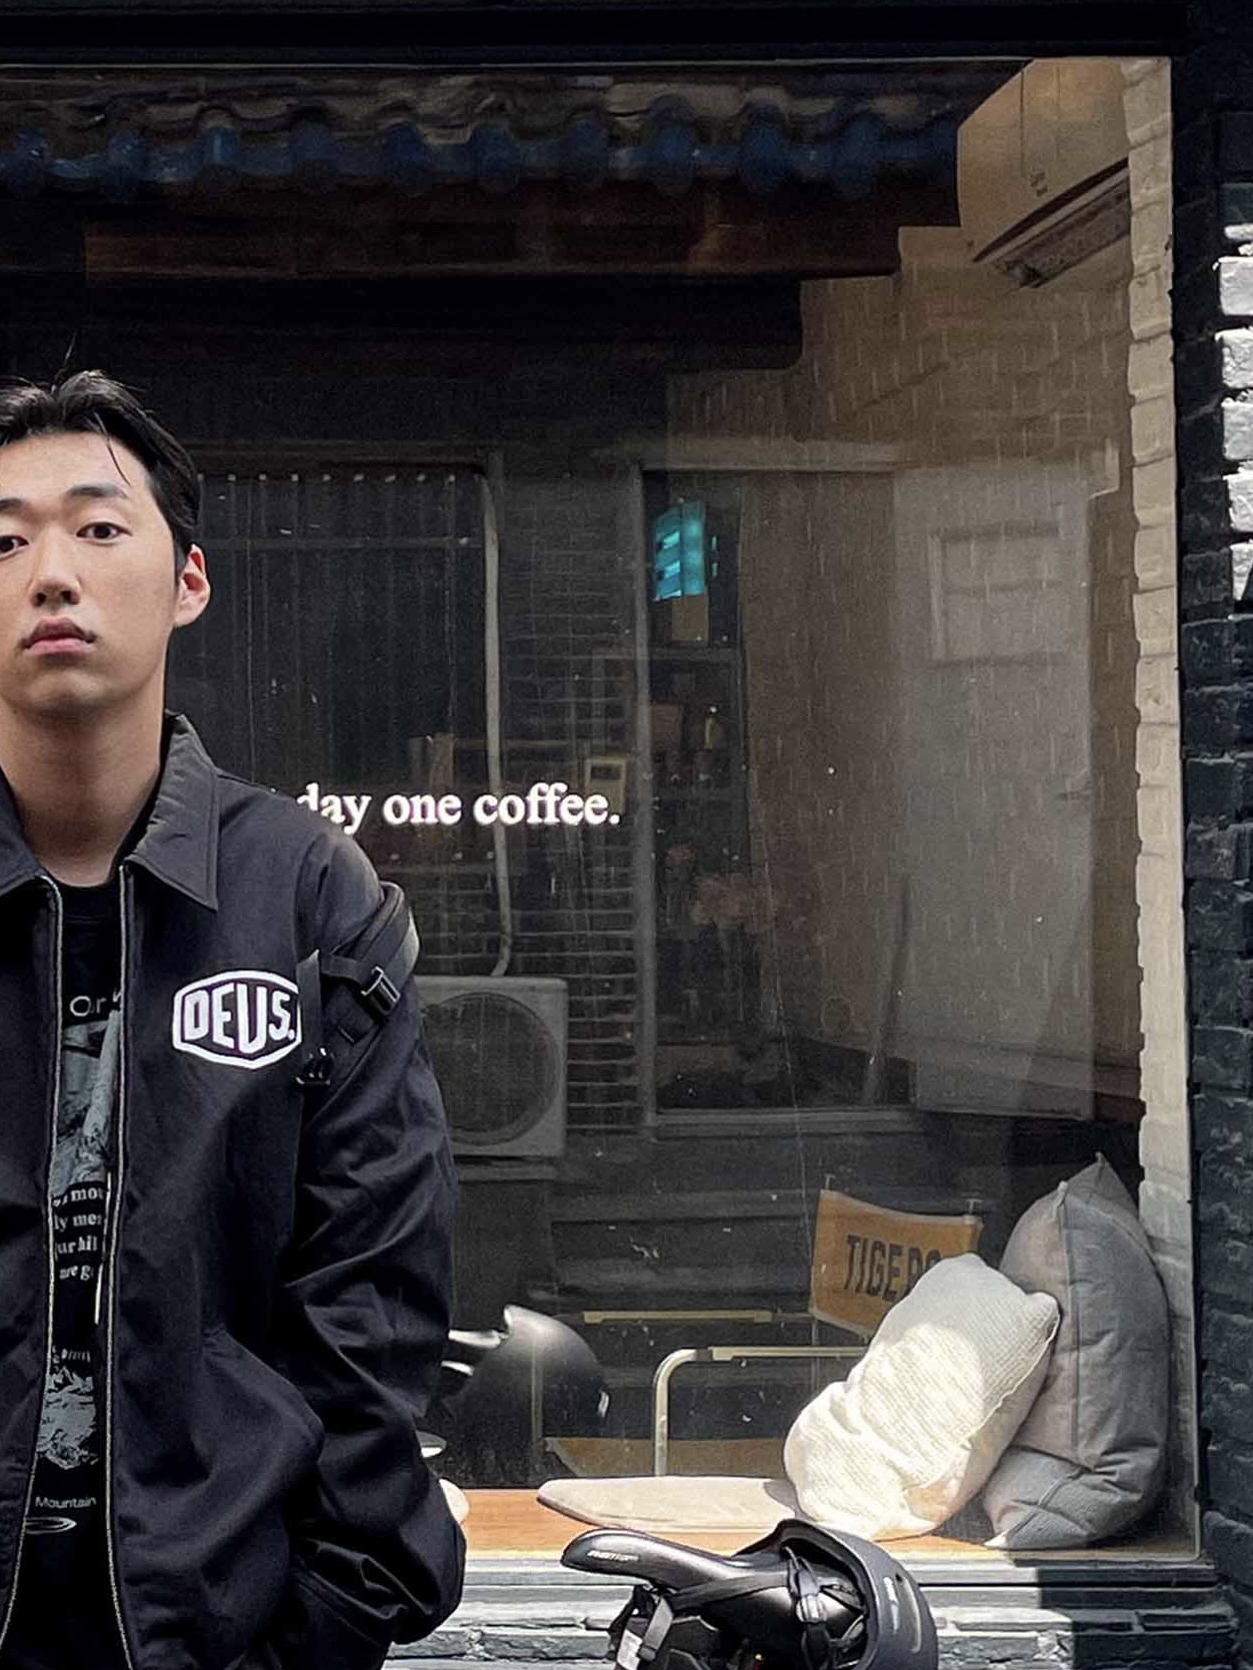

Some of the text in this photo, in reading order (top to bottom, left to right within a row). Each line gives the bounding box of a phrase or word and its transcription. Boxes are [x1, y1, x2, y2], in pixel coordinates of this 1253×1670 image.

[382, 795, 462, 825] one
[473, 781, 621, 826] coffee.
[183, 982, 296, 1054] DEUS.
